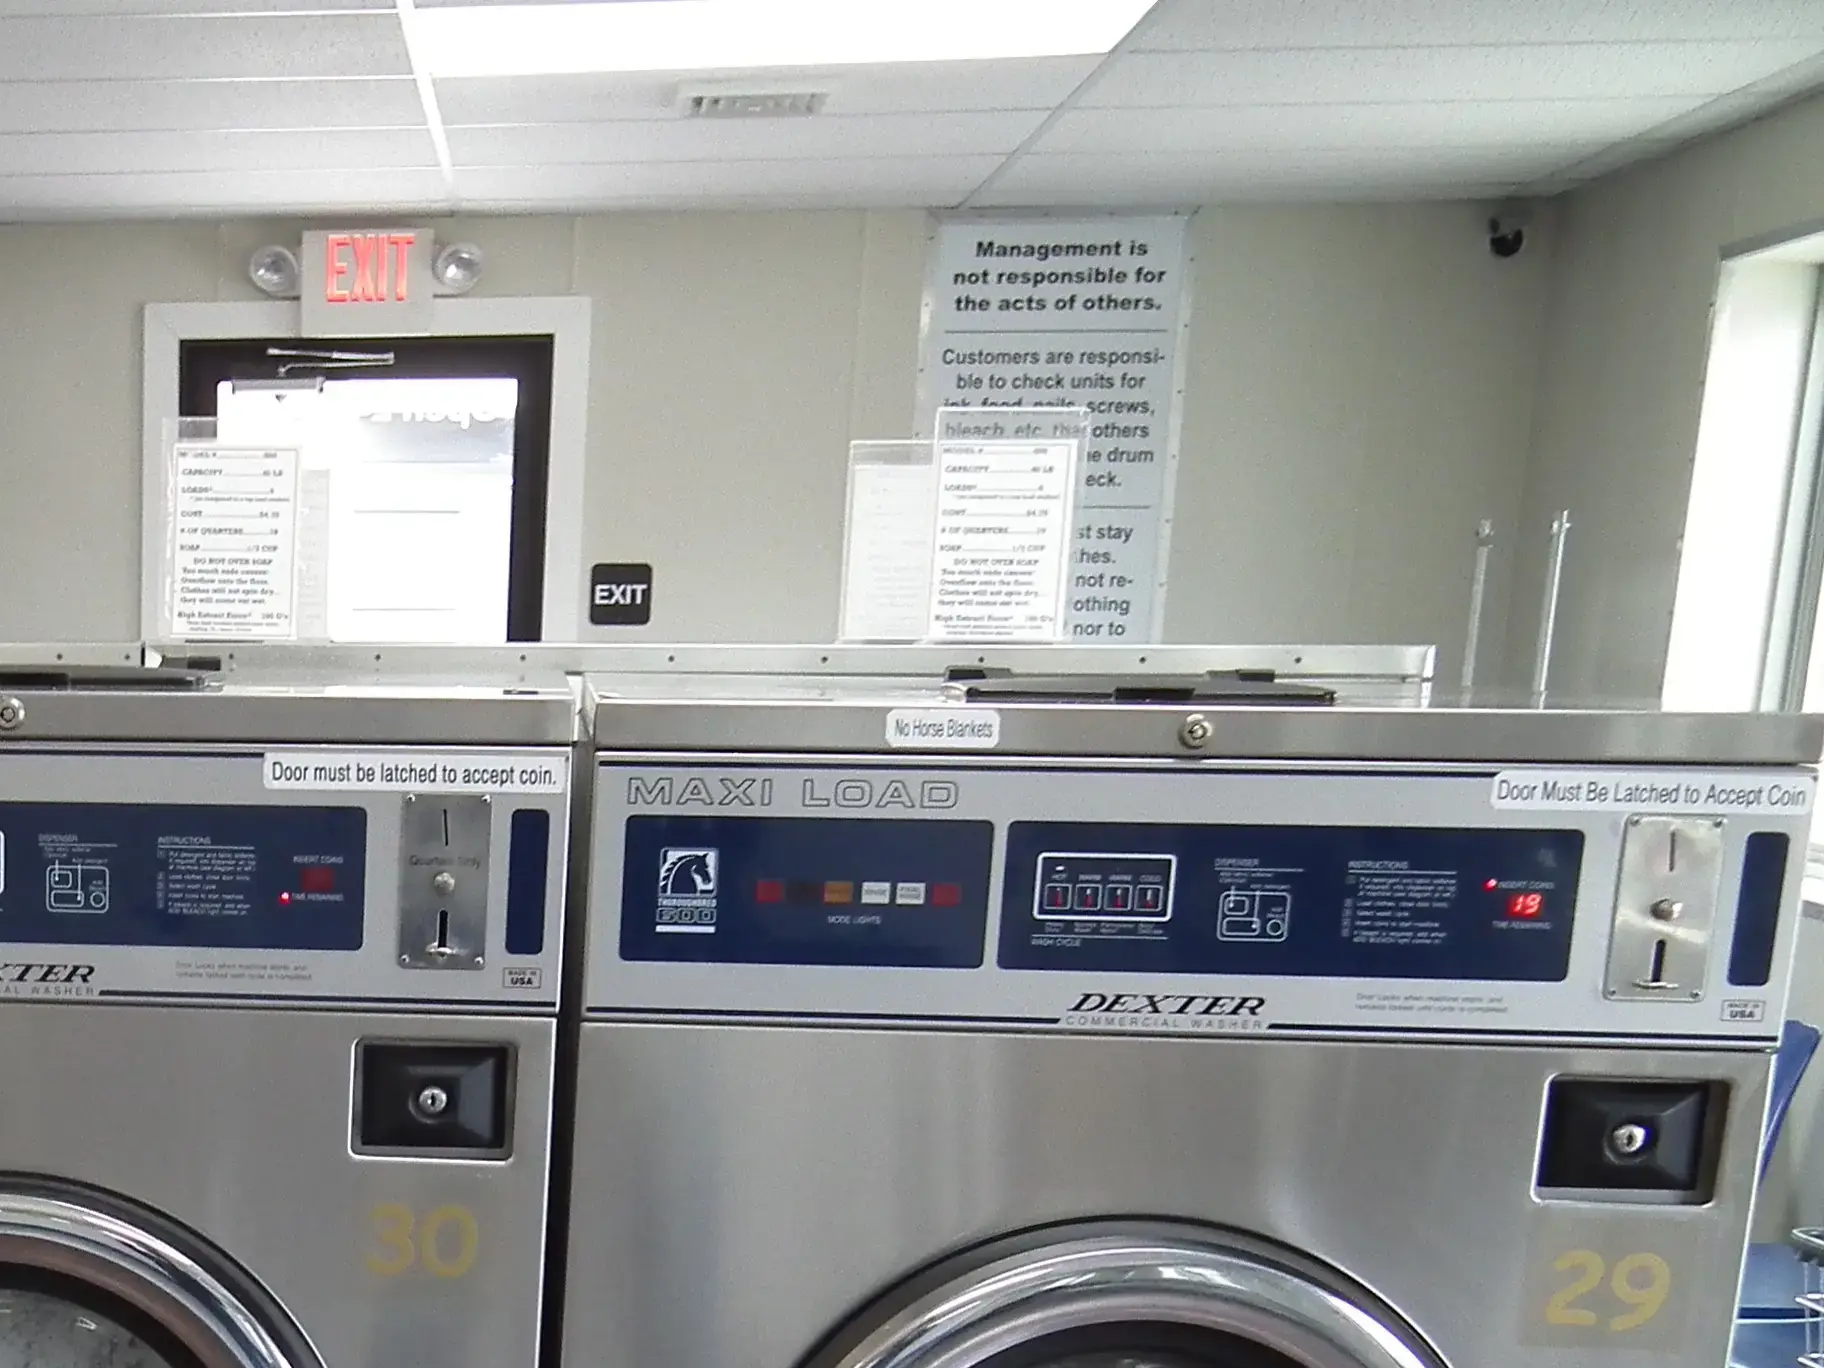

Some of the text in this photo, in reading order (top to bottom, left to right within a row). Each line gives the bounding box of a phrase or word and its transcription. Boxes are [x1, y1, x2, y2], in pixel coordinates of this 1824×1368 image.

[974, 240, 1150, 262] Management is
[325, 233, 415, 302] EXIT
[951, 265, 1168, 288] not responsible for
[954, 293, 1163, 312] the acts of others.
[941, 347, 1166, 368] Customers are responsi-
[955, 371, 1146, 390] ble to check units for
[1086, 399, 1156, 417] screws,
[1091, 423, 1150, 439] others
[1106, 446, 1156, 464] drum
[1084, 470, 1123, 488] eck.
[1074, 524, 1135, 544] st stay
[1075, 572, 1135, 588] not re-
[593, 583, 648, 606] EXIT
[1072, 596, 1132, 617] othing
[1072, 621, 1126, 637] nor to
[893, 718, 994, 740] No Horse Blankets
[271, 761, 557, 788] Door must be latched to accept coin.
[626, 776, 960, 810] MAXI LOAD
[1496, 779, 1807, 809] Door Must Be Latched to Accept Coin
[1512, 893, 1543, 915] 19
[30, 985, 95, 998] WASHER
[510, 976, 533, 986] USA
[1066, 992, 1268, 1017] DEXTER
[1729, 1009, 1755, 1019] USA
[1064, 1015, 1264, 1031] COMMERCIAL WASHER
[365, 1202, 478, 1279] 30
[1544, 1248, 1671, 1332] 29
